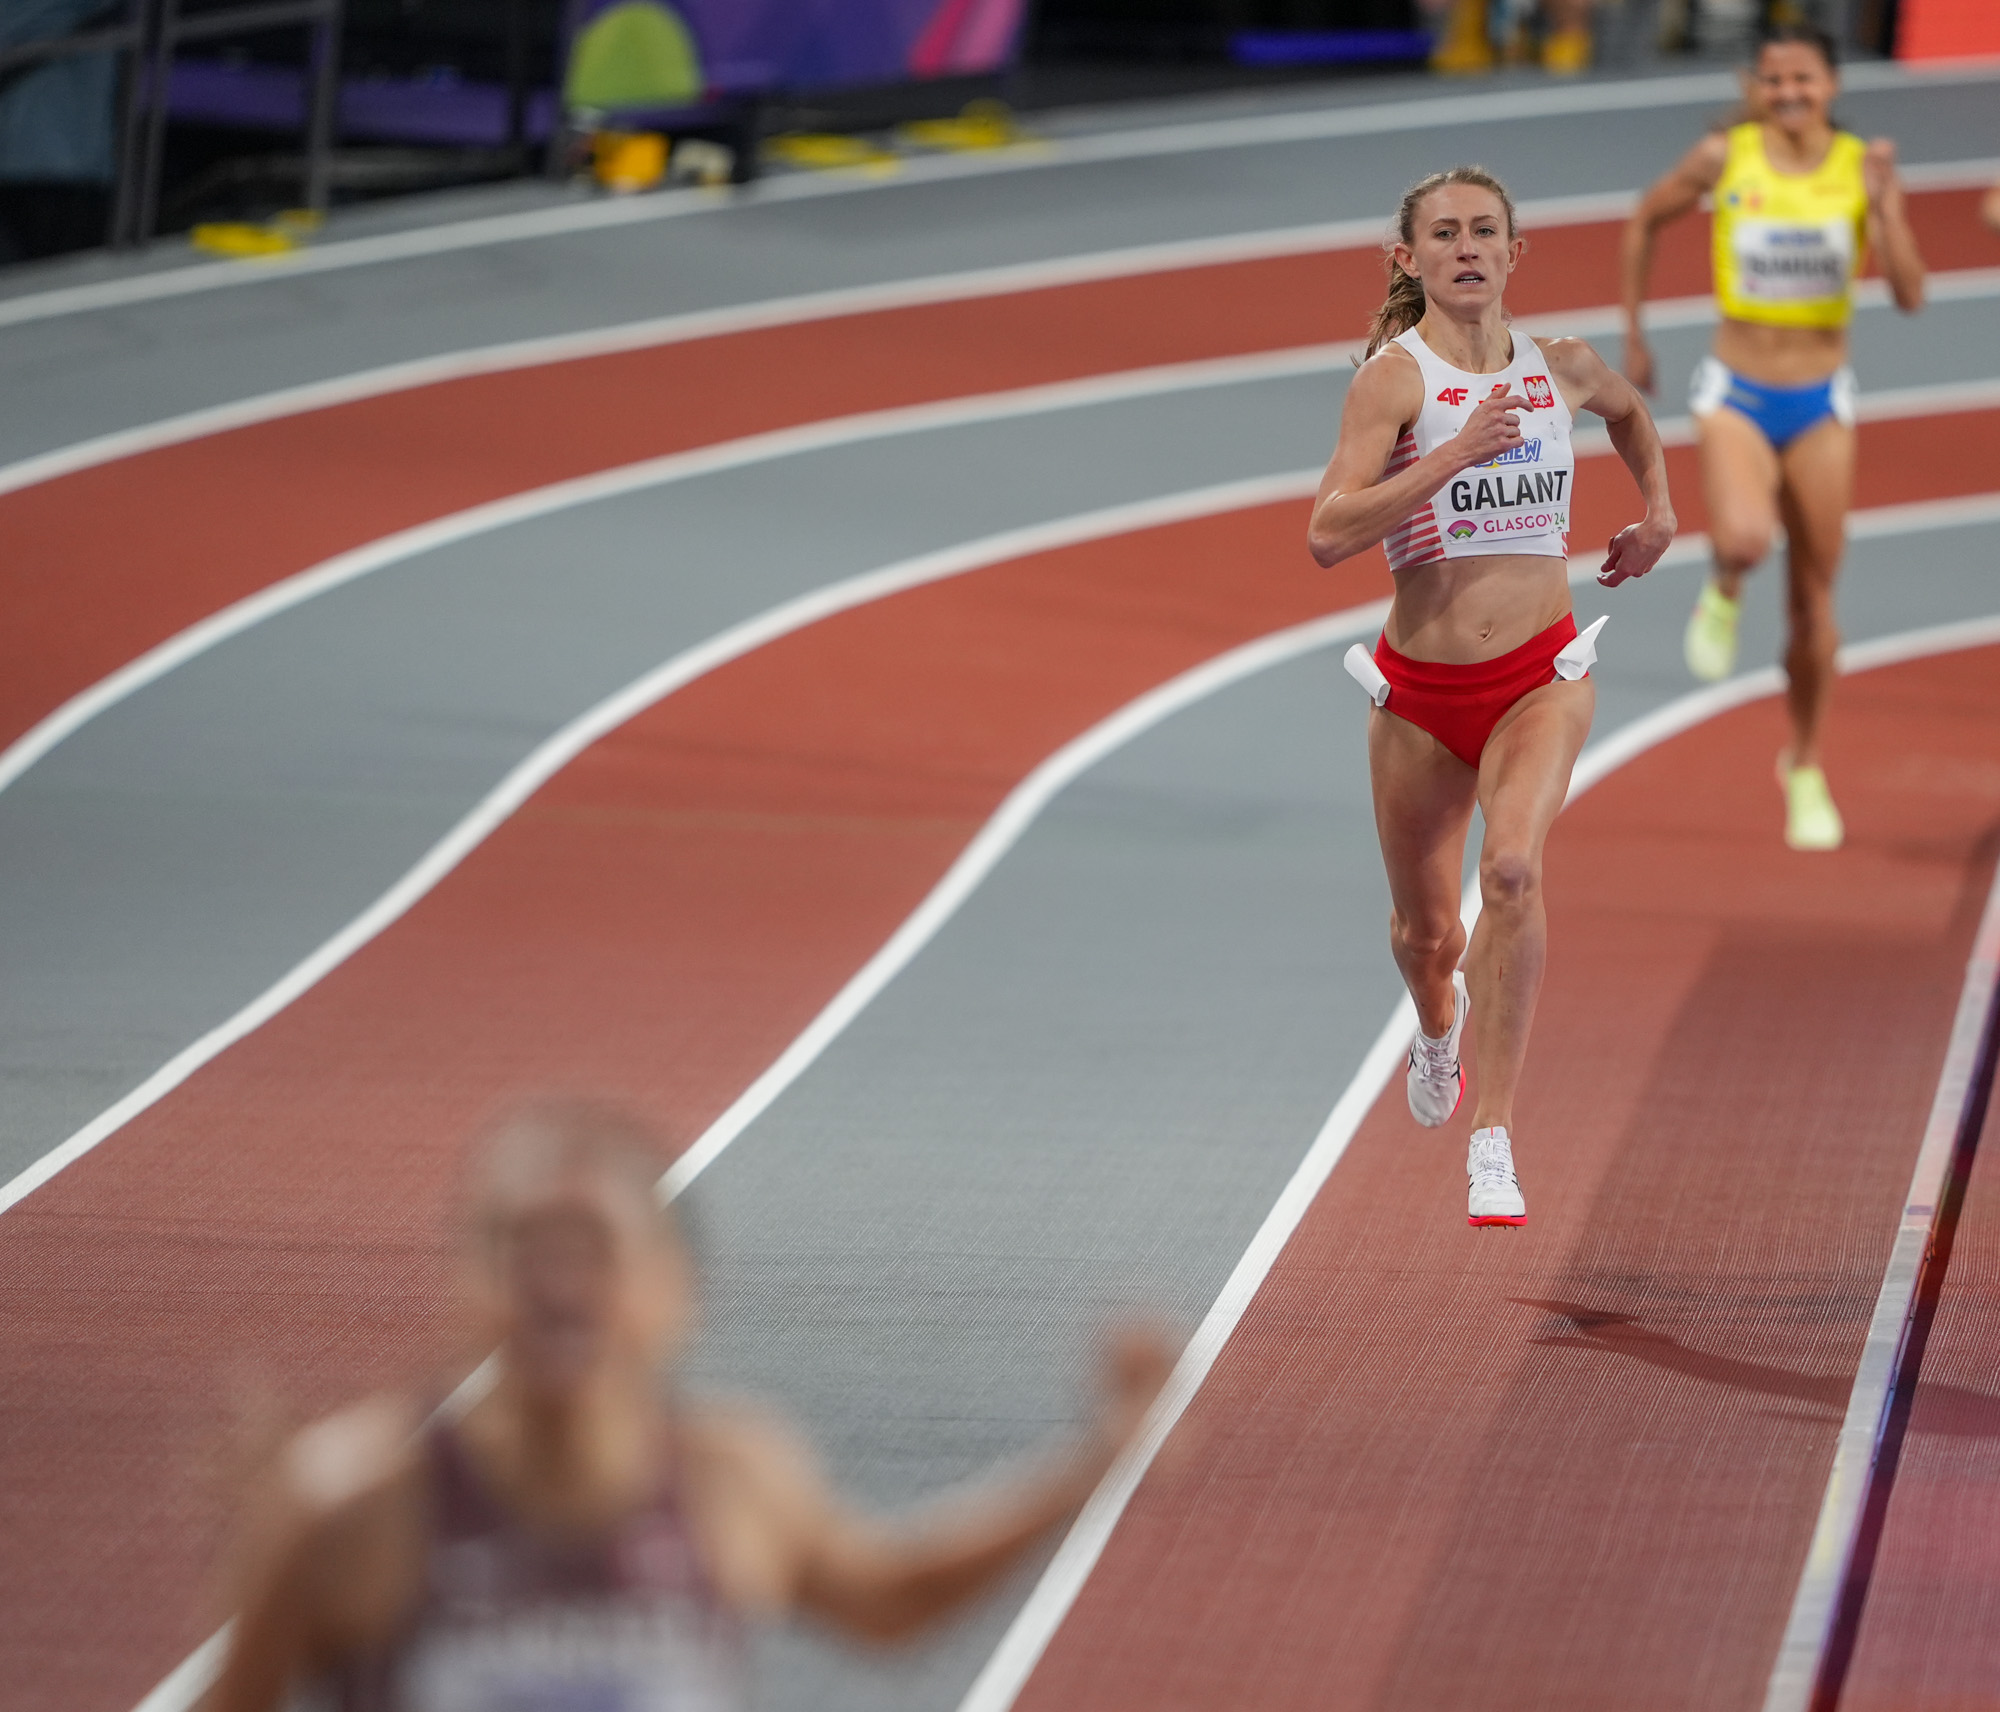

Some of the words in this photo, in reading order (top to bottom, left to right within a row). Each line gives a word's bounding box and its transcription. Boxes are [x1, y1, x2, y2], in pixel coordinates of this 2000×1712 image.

[1437, 388, 1469, 406] 4F
[1451, 470, 1568, 512] GALANT
[1554, 512, 1566, 525] 24
